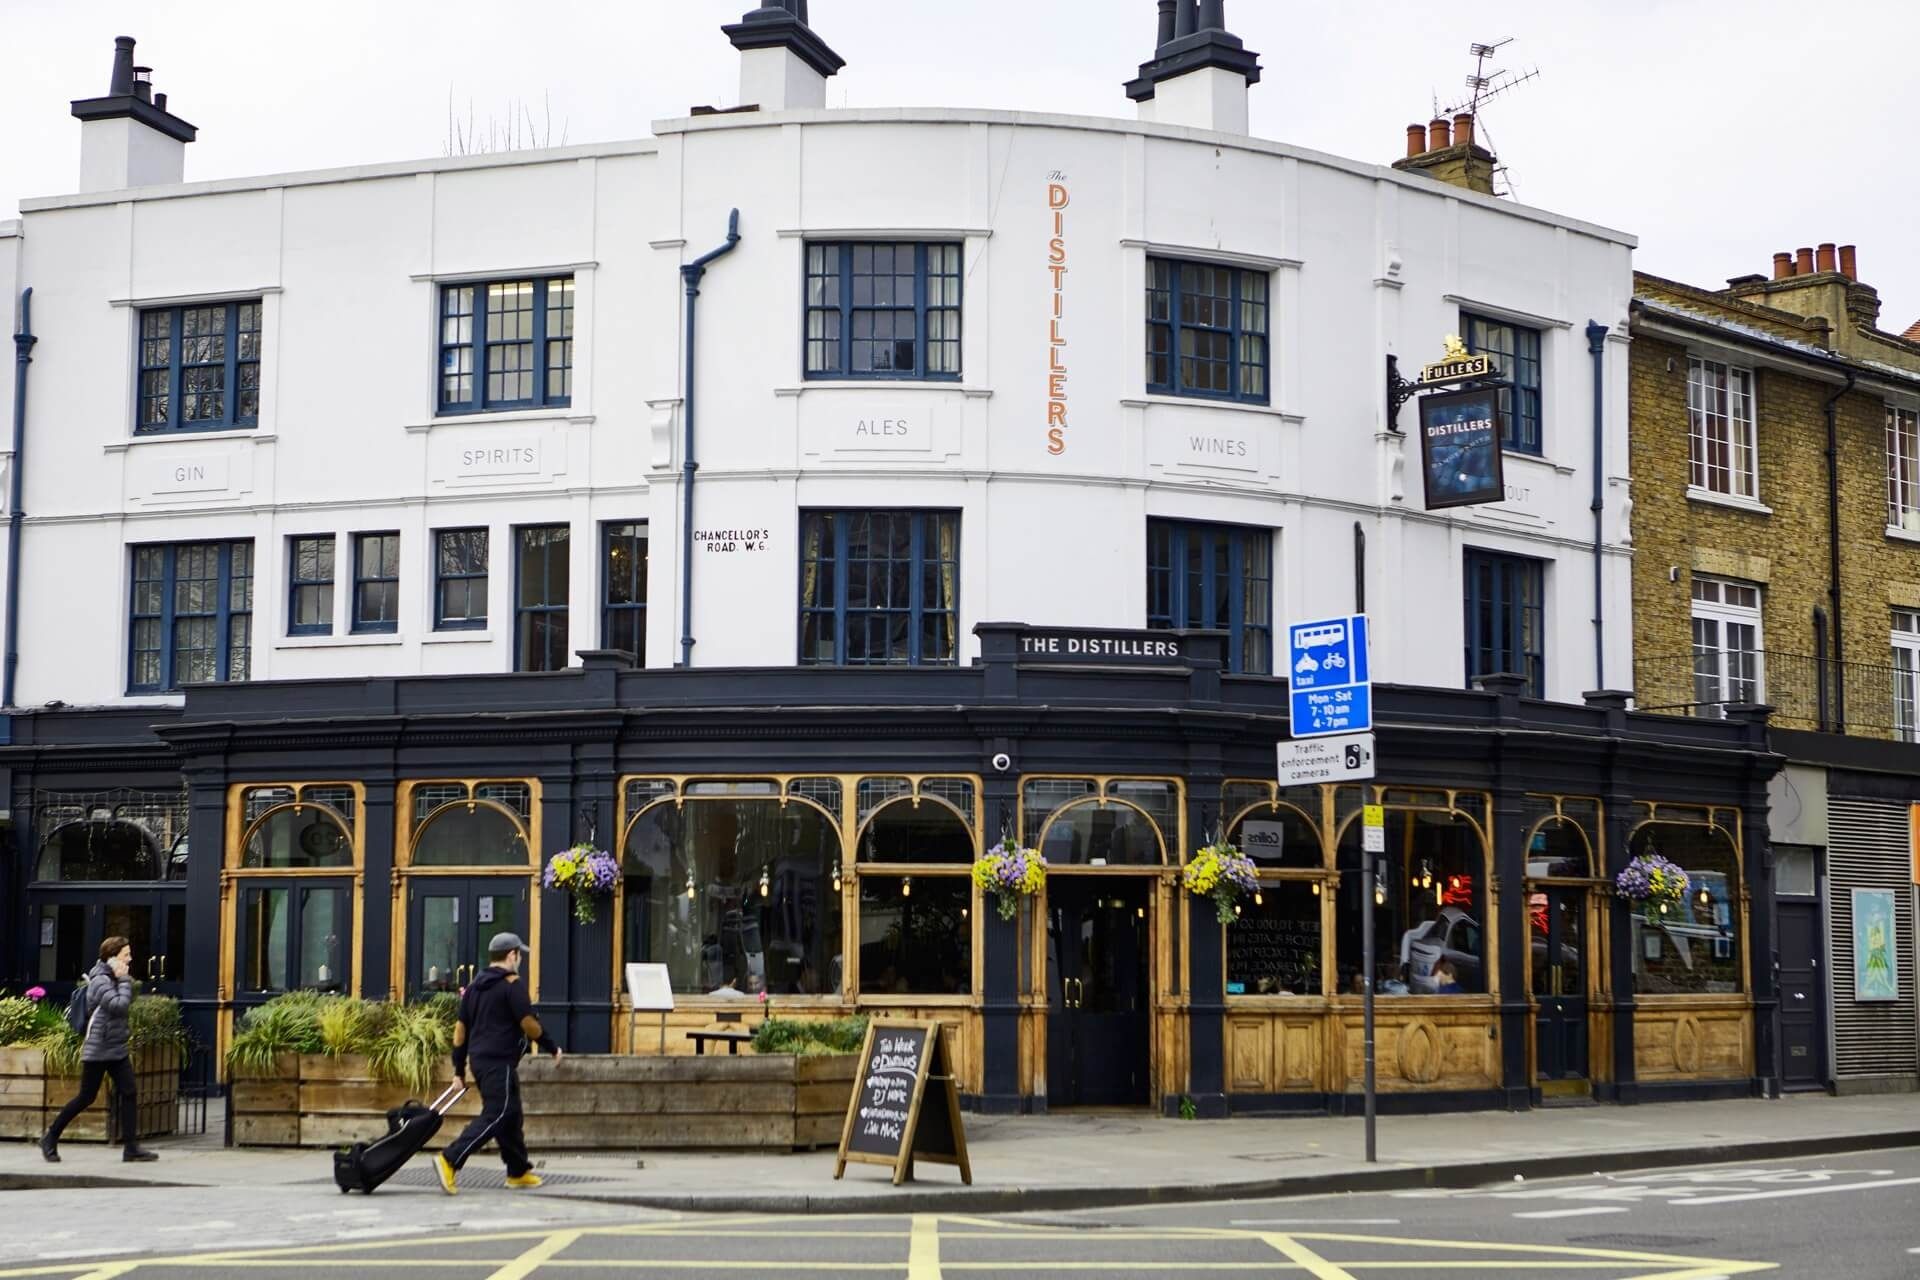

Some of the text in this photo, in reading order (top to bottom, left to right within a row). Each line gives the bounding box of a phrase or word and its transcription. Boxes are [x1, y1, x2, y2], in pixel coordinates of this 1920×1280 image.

[1048, 184, 1070, 455] DISTILLERS
[856, 419, 908, 436] ALES
[1427, 418, 1492, 437] DISTILLERS
[1190, 436, 1247, 456] WINES
[463, 448, 534, 465] SPIRITS
[175, 466, 204, 481] GIN
[1504, 484, 1530, 502] OUT
[694, 528, 769, 541] CHANCELLOR'S
[1022, 637, 1178, 656] THE DISTILLERS
[1296, 675, 1314, 686] taxi
[1294, 744, 1324, 754] Traffic
[1281, 755, 1339, 768] enforcement
[1291, 769, 1329, 780] cameras
